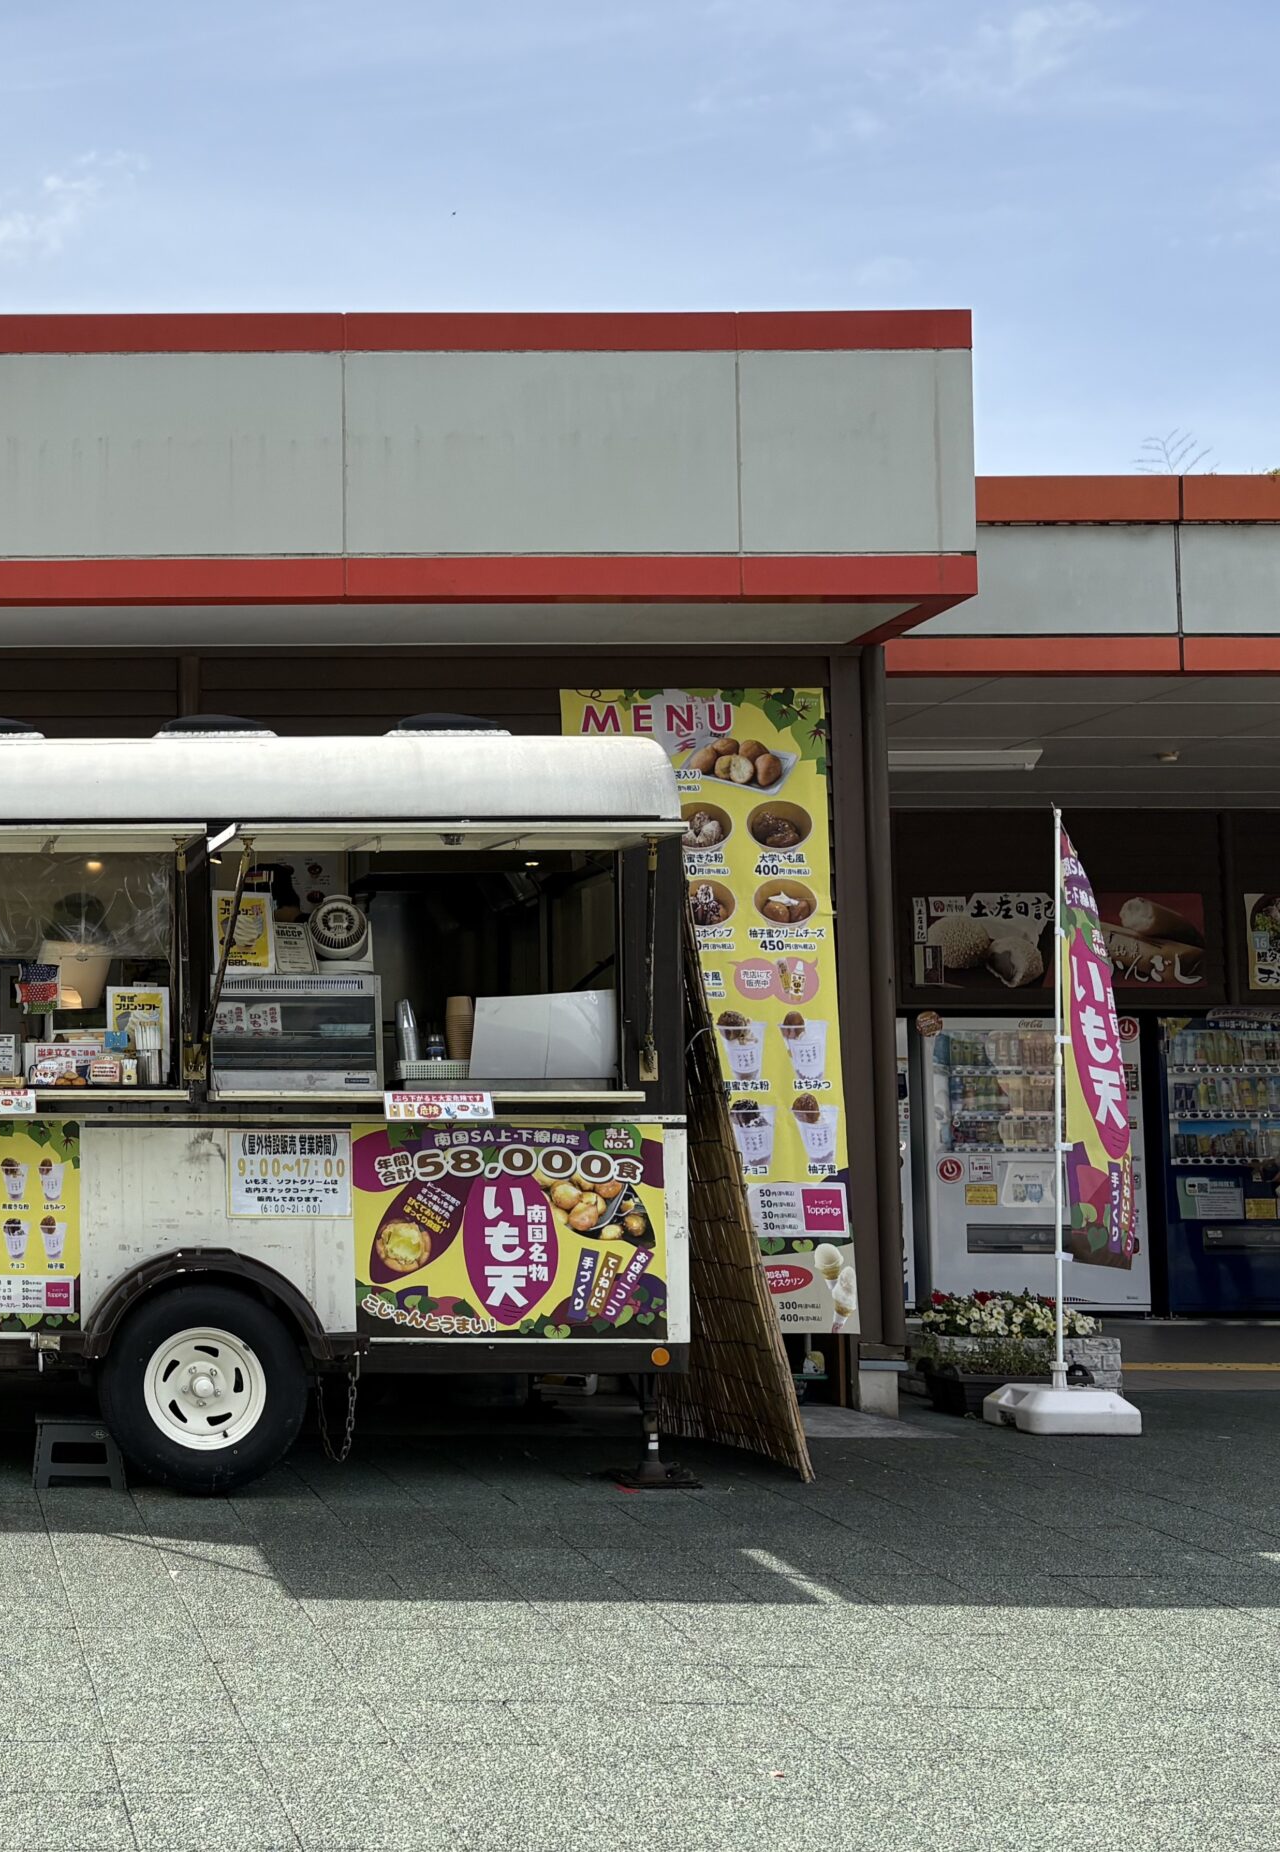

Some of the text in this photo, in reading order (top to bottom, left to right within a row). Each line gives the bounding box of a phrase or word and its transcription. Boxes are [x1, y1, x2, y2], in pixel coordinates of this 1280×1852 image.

[581, 703, 733, 733] MENU
[683, 853, 724, 863] 蜜きな粉
[759, 853, 805, 863] 大学いも風
[749, 928, 825, 938] 柚子蜜クリームチーズ
[746, 979, 769, 988] 販売中
[114, 1003, 160, 1011] プリンソフト
[1072, 955, 1127, 1129] いも天
[793, 1080, 831, 1089] はちみつ
[419, 1105, 440, 1117] 危険
[605, 1128, 629, 1139] 売上
[603, 1138, 634, 1150] No.1
[376, 1154, 410, 1170] 年間
[381, 1167, 413, 1183] 合計
[742, 1165, 768, 1174] チョコ
[808, 1164, 836, 1174] 柚子蜜
[407, 1197, 451, 1229] 甘くておいしい
[806, 1205, 841, 1216] Toppings
[483, 1186, 529, 1308] いも天
[527, 1204, 549, 1282] 南国名物
[573, 1256, 594, 1311] 手づくり
[590, 1257, 618, 1308] ていねいに
